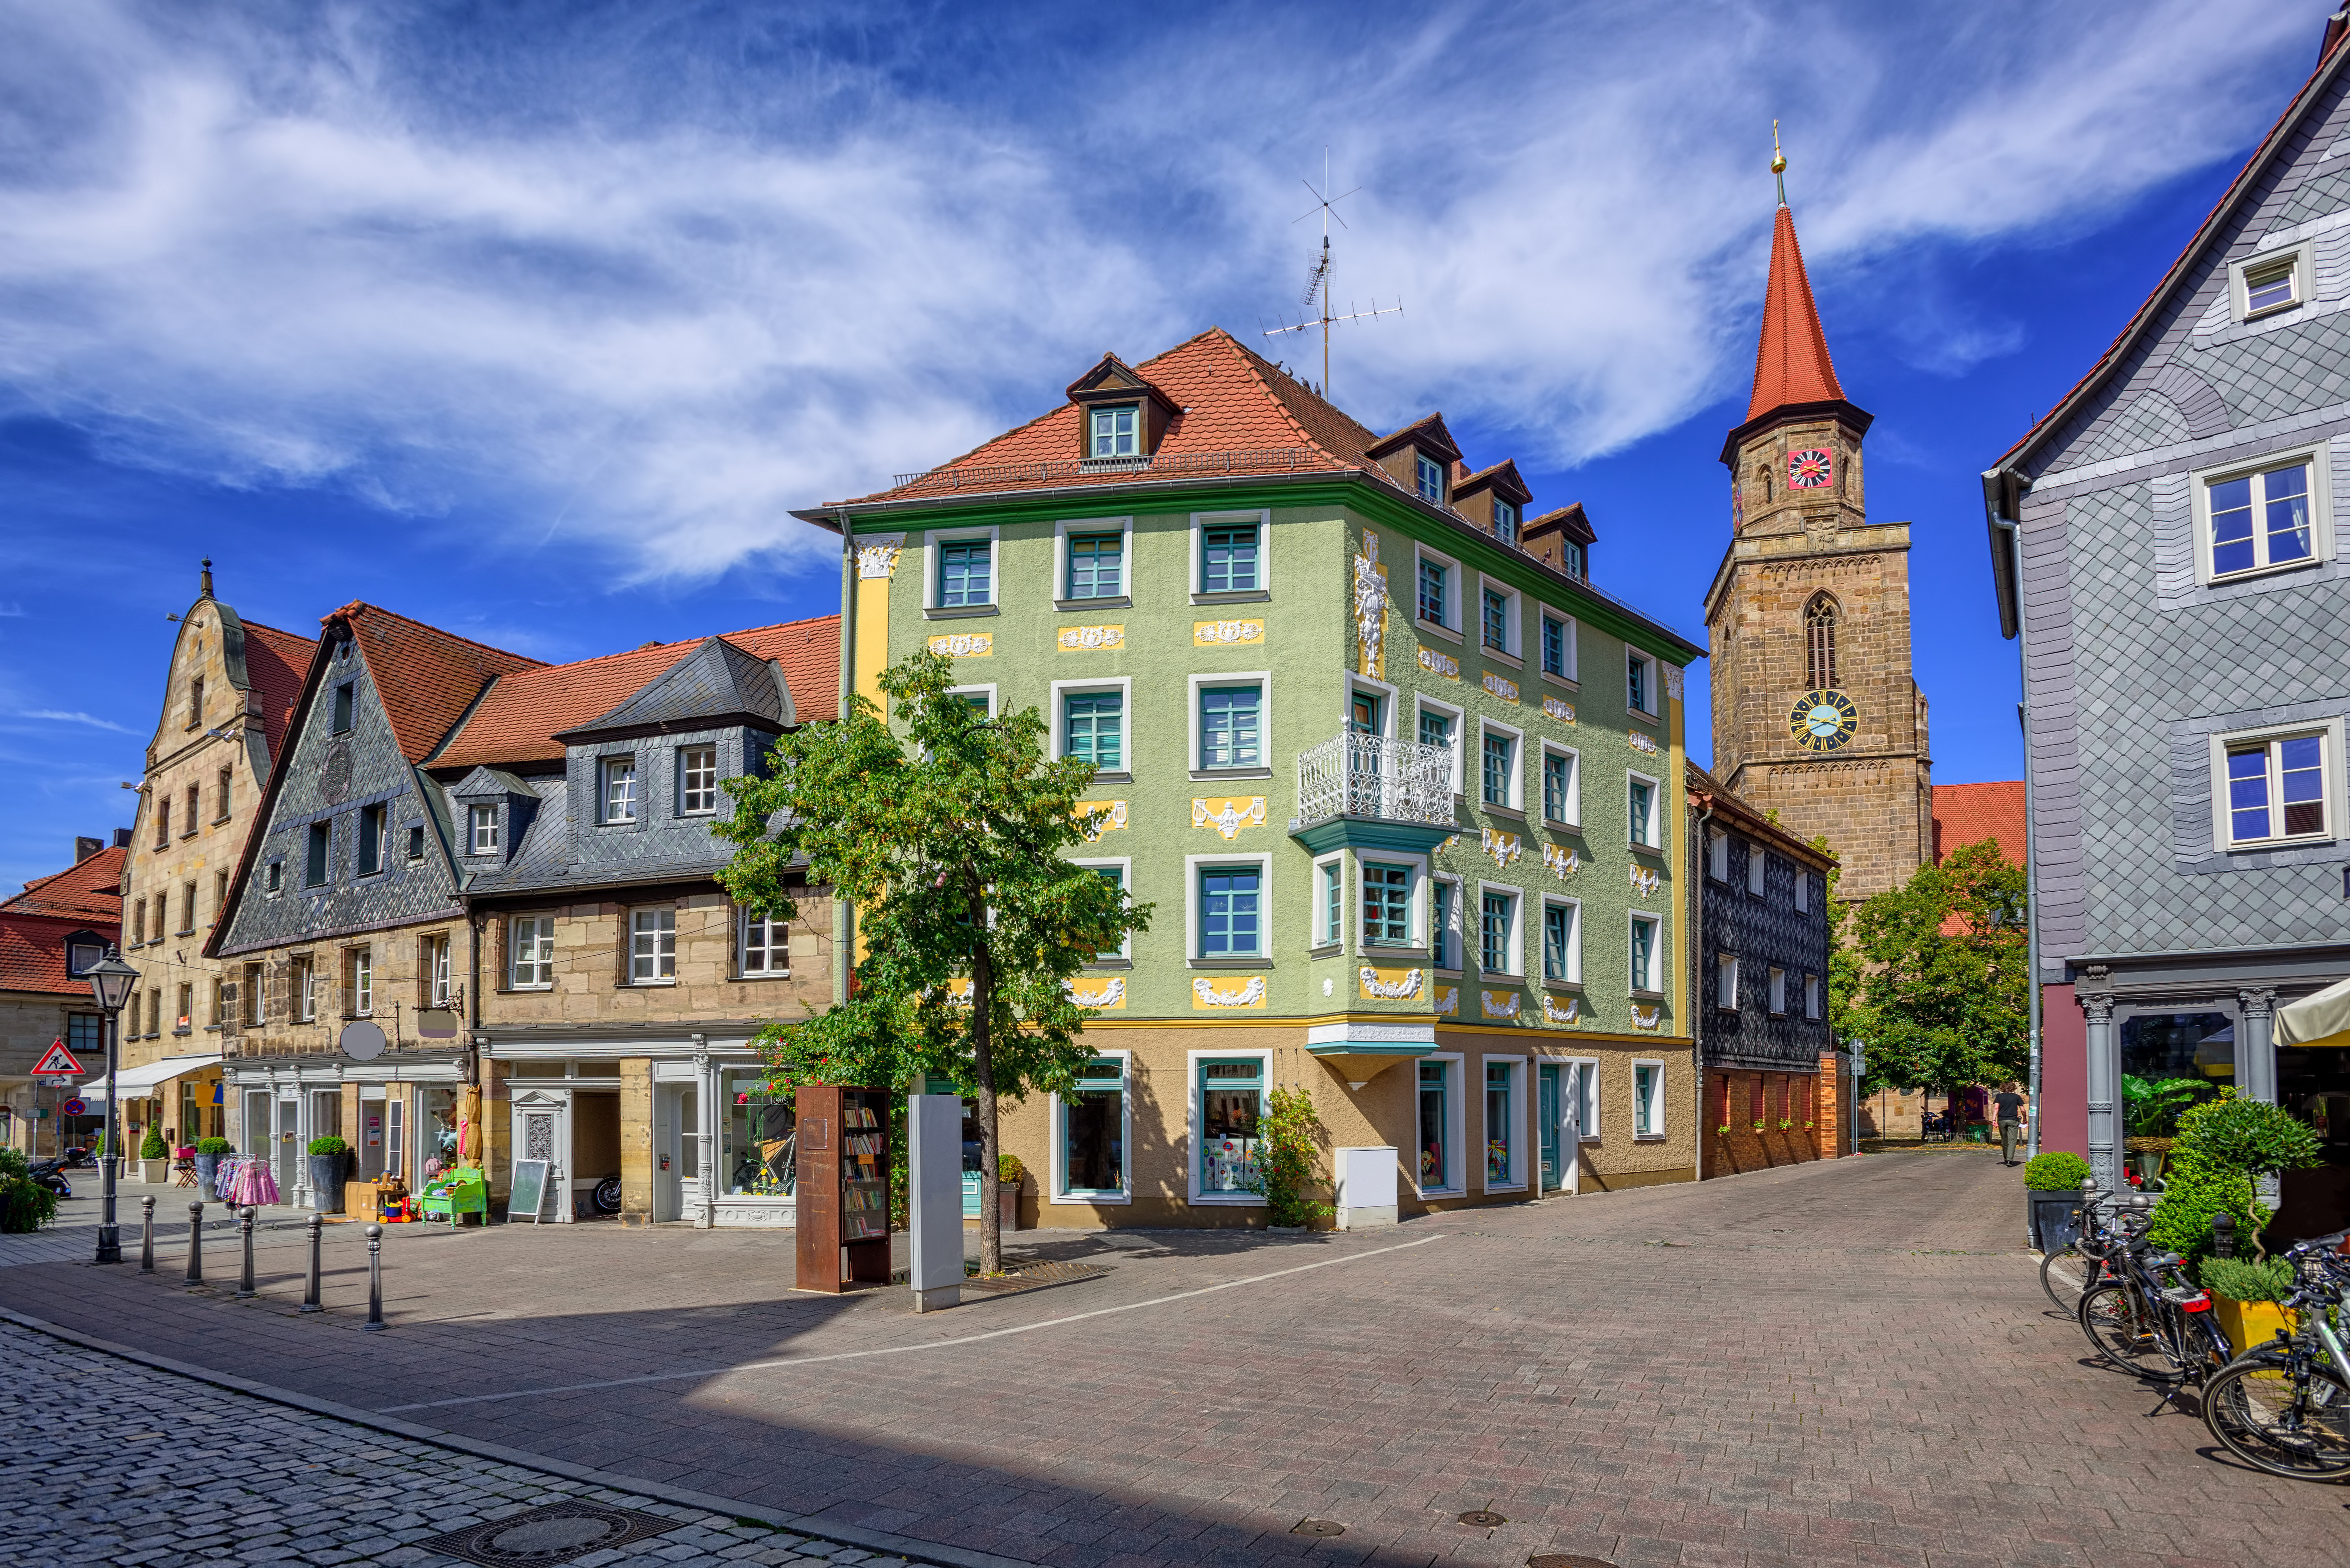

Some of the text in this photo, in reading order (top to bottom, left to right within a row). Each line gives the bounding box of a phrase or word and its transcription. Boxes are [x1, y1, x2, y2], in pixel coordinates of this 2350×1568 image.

[1797, 453, 1806, 463] XI
[1814, 452, 1820, 461] I
[1808, 478, 1813, 487] VI
[1815, 476, 1823, 485] V
[1802, 696, 1816, 709] XI
[1818, 691, 1827, 704] XII
[1833, 694, 1842, 707] I
[1793, 706, 1808, 717] X
[1839, 703, 1853, 713] II
[1839, 727, 1853, 737] IV
[1805, 735, 1817, 749] VII
[1820, 737, 1828, 750] VI
[1833, 735, 1844, 747] V
